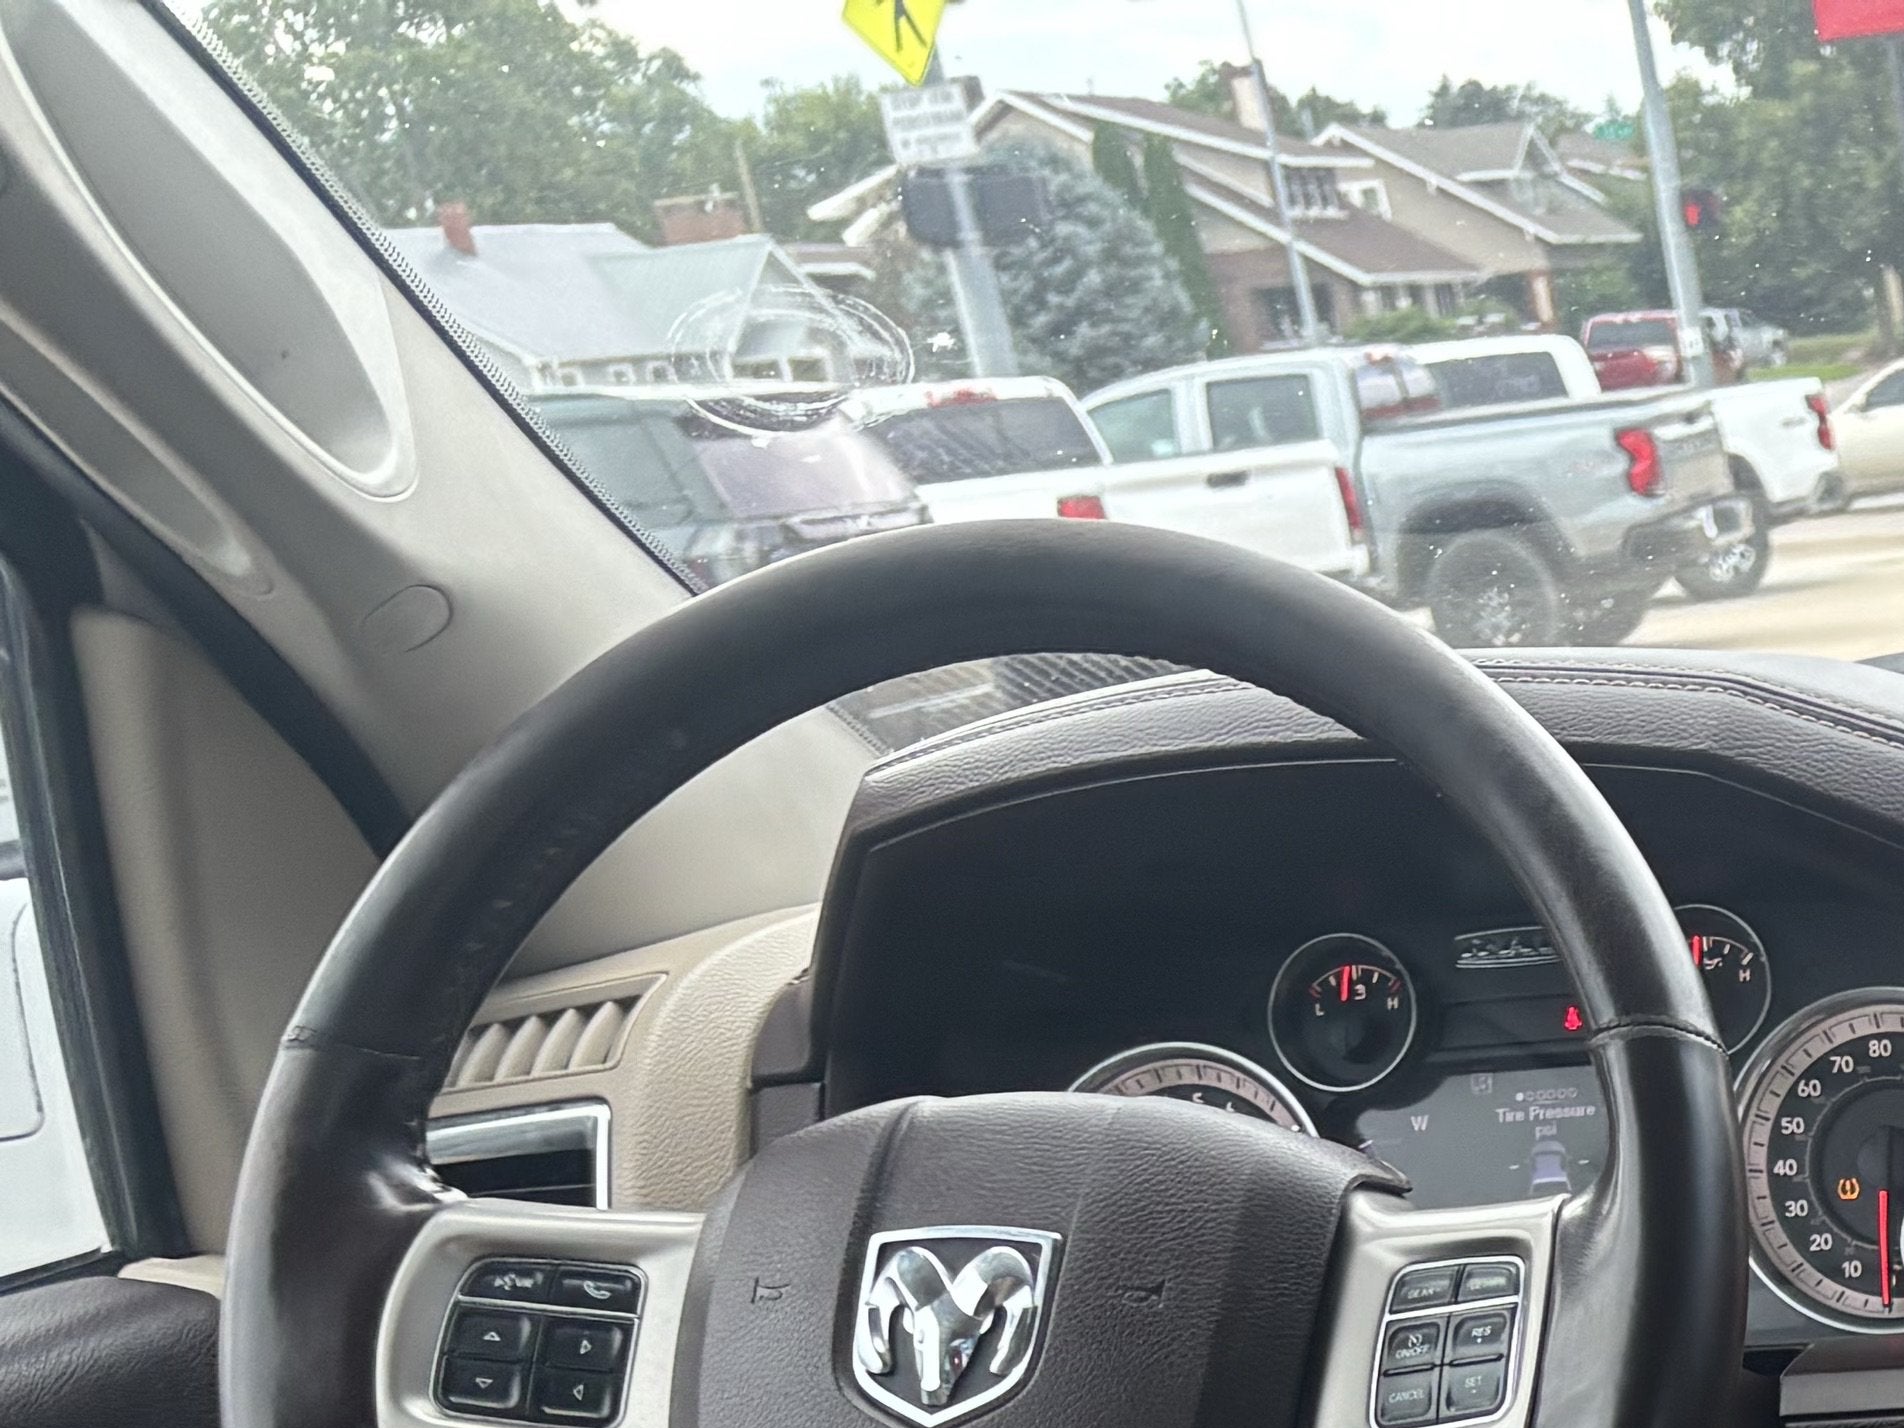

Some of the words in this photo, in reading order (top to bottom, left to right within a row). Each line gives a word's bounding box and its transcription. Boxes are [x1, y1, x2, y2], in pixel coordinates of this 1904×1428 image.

[1739, 968, 1751, 982] H
[1868, 1039, 1892, 1058] 80
[1829, 1056, 1854, 1074] 70
[1797, 1079, 1822, 1097] 60
[1496, 1108, 1525, 1123] Tire
[1529, 1104, 1596, 1121] Pressure
[1410, 1114, 1429, 1131] W
[1780, 1117, 1805, 1134] 50
[1773, 1159, 1797, 1176] 40
[1785, 1199, 1808, 1217] 30
[1809, 1233, 1833, 1251] 20
[1841, 1260, 1862, 1278] 10
[1471, 1325, 1492, 1337] RES
[1465, 1375, 1482, 1388] SET
[1389, 1389, 1425, 1403] CANCEL
